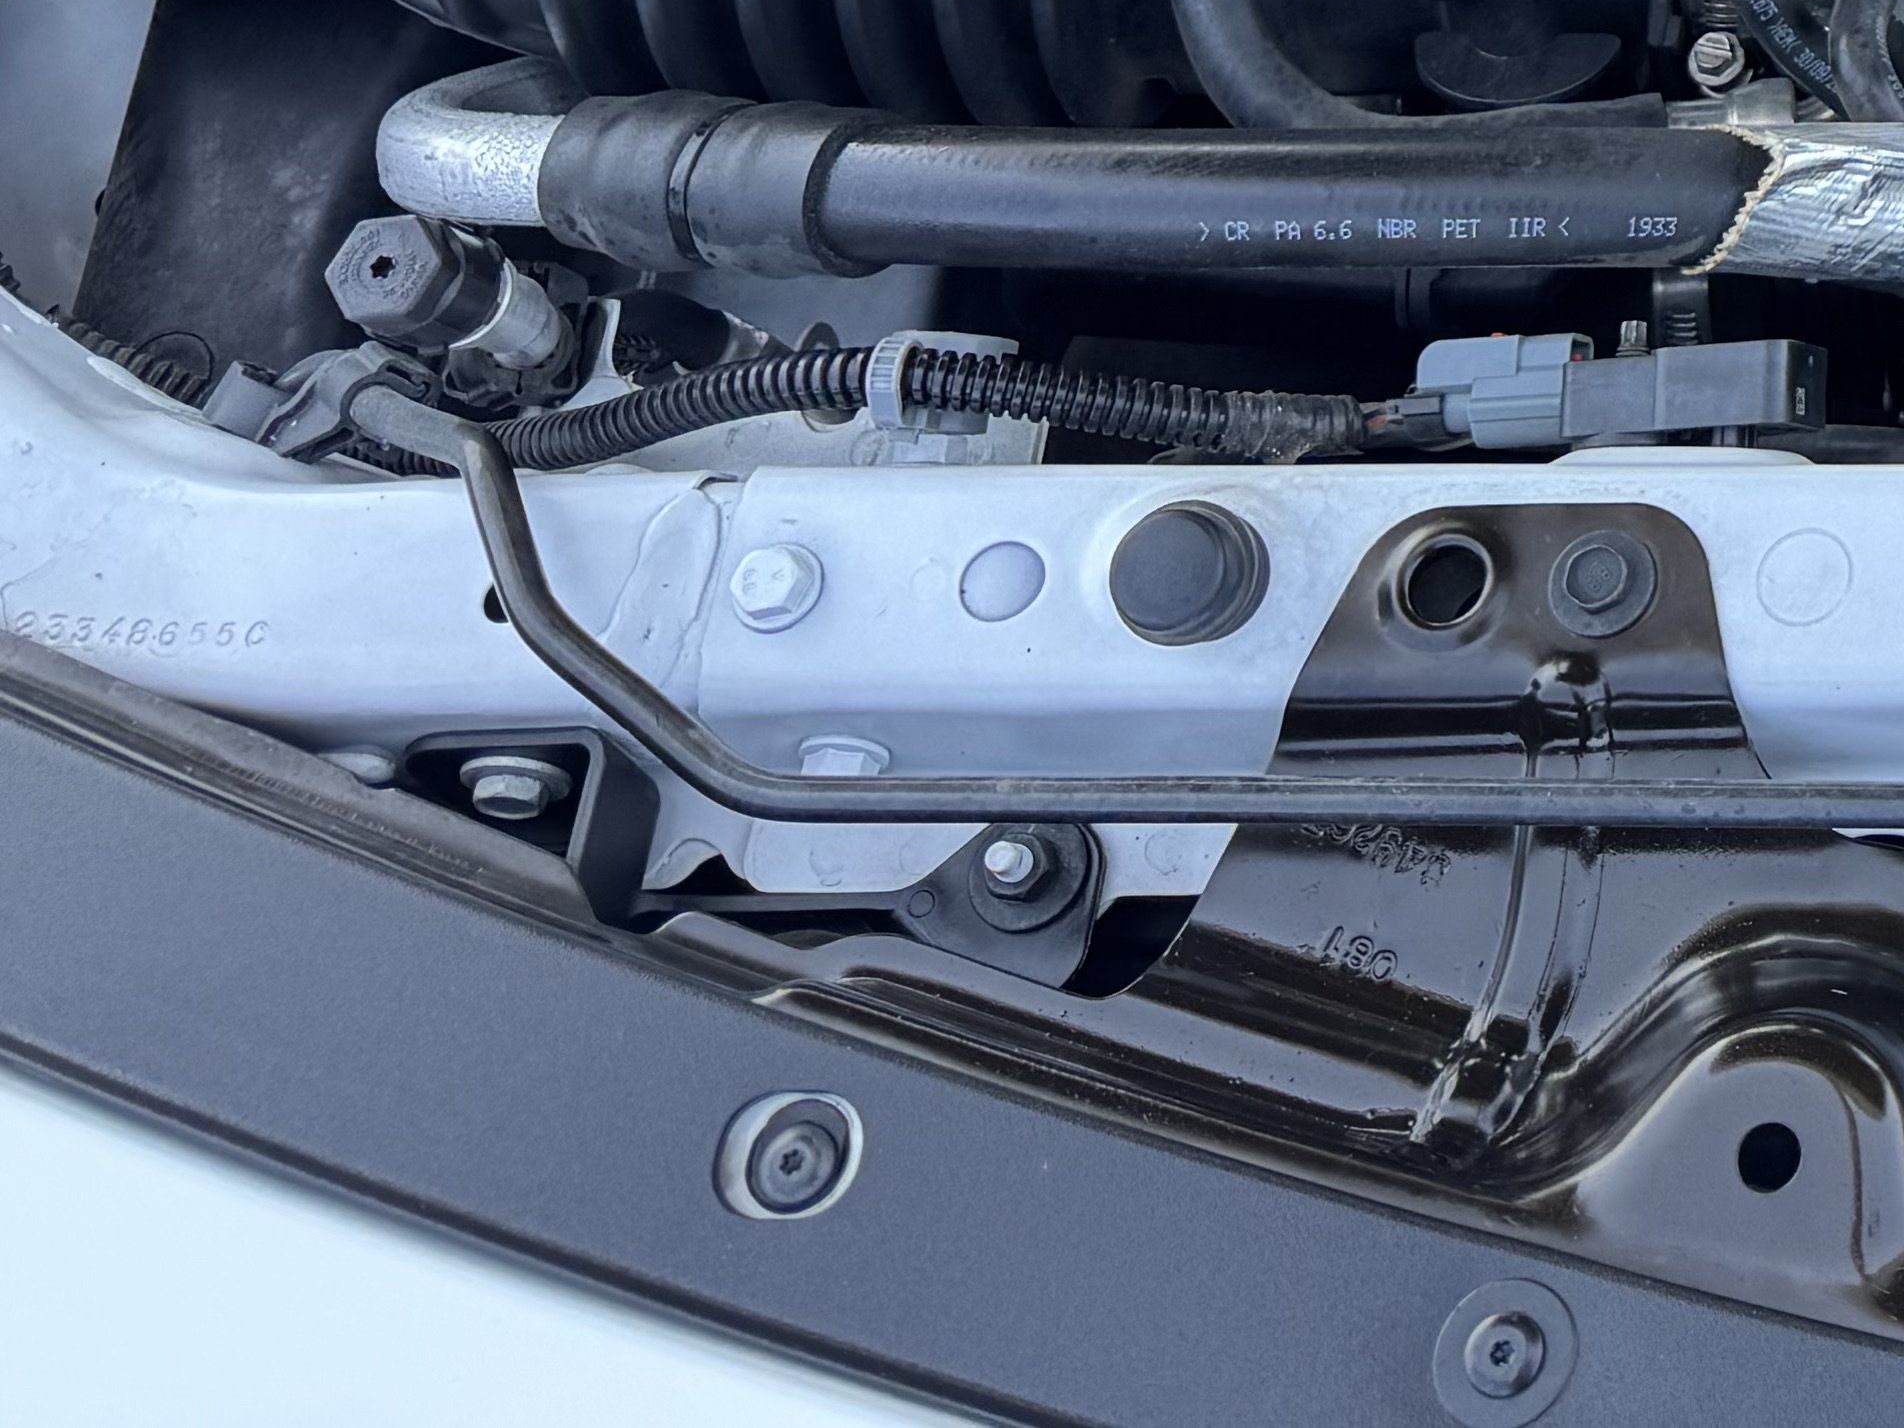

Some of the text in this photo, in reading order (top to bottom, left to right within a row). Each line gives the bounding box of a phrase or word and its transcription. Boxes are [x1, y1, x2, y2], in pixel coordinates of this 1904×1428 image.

[1224, 222, 1250, 242] CR
[1274, 221, 1301, 241] PA
[1313, 220, 1353, 240] 6.6
[1377, 219, 1417, 239] NBR
[1442, 218, 1481, 239] PET
[1508, 218, 1547, 239] IIR
[1626, 216, 1678, 237] 1933
